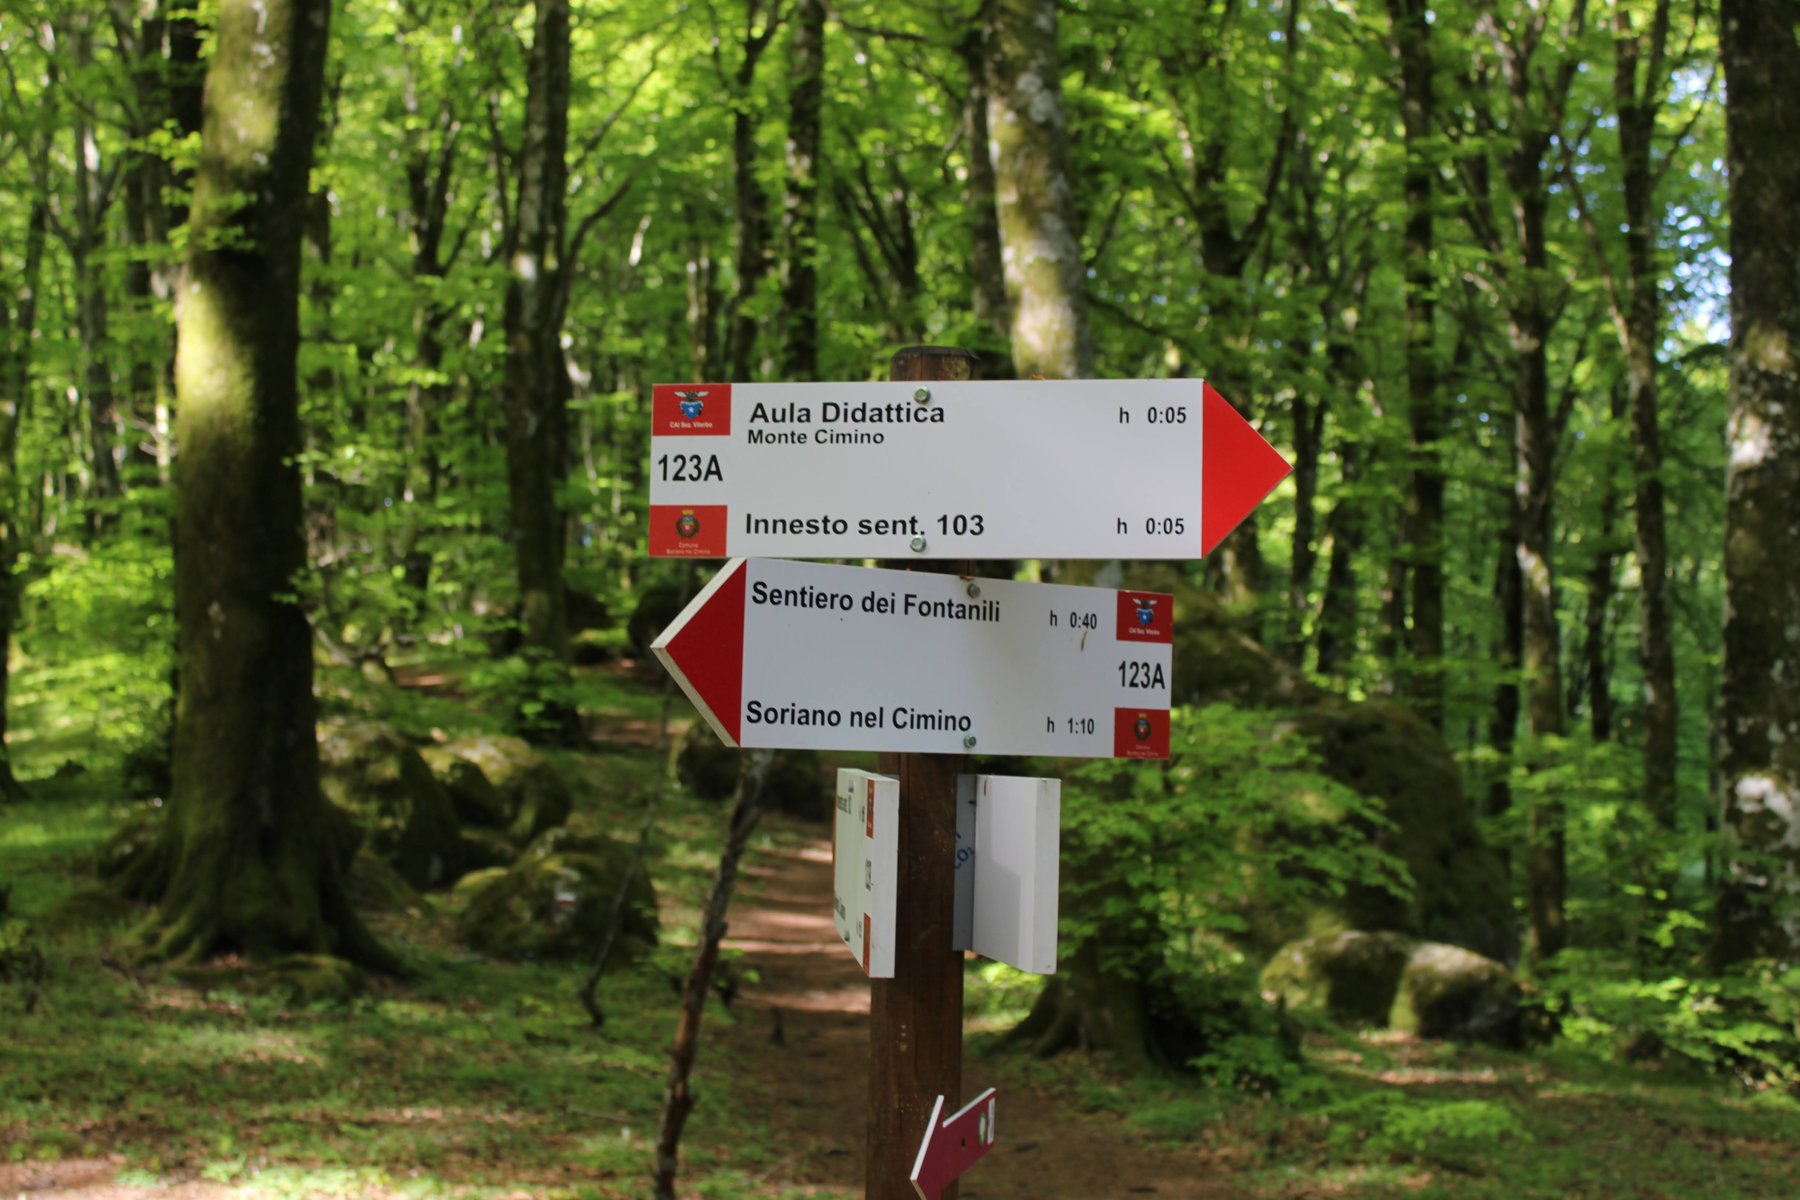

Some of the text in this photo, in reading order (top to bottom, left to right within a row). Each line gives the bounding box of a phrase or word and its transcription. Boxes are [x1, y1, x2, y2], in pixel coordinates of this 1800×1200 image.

[750, 402, 945, 423] Aula Didattica
[1119, 407, 1187, 424] h 0:05
[748, 429, 885, 444] Monte Cimino
[658, 455, 724, 481] 123A
[746, 514, 985, 535] Innesto sent. 103
[1117, 518, 1185, 535] h 0:05
[752, 581, 1000, 622] Sentiero dei Fontanili
[1049, 610, 1098, 630] h 0:40
[1118, 660, 1166, 690] 123A
[746, 701, 972, 732] Soriano nel Cimino
[1046, 716, 1095, 735] h 1:10
